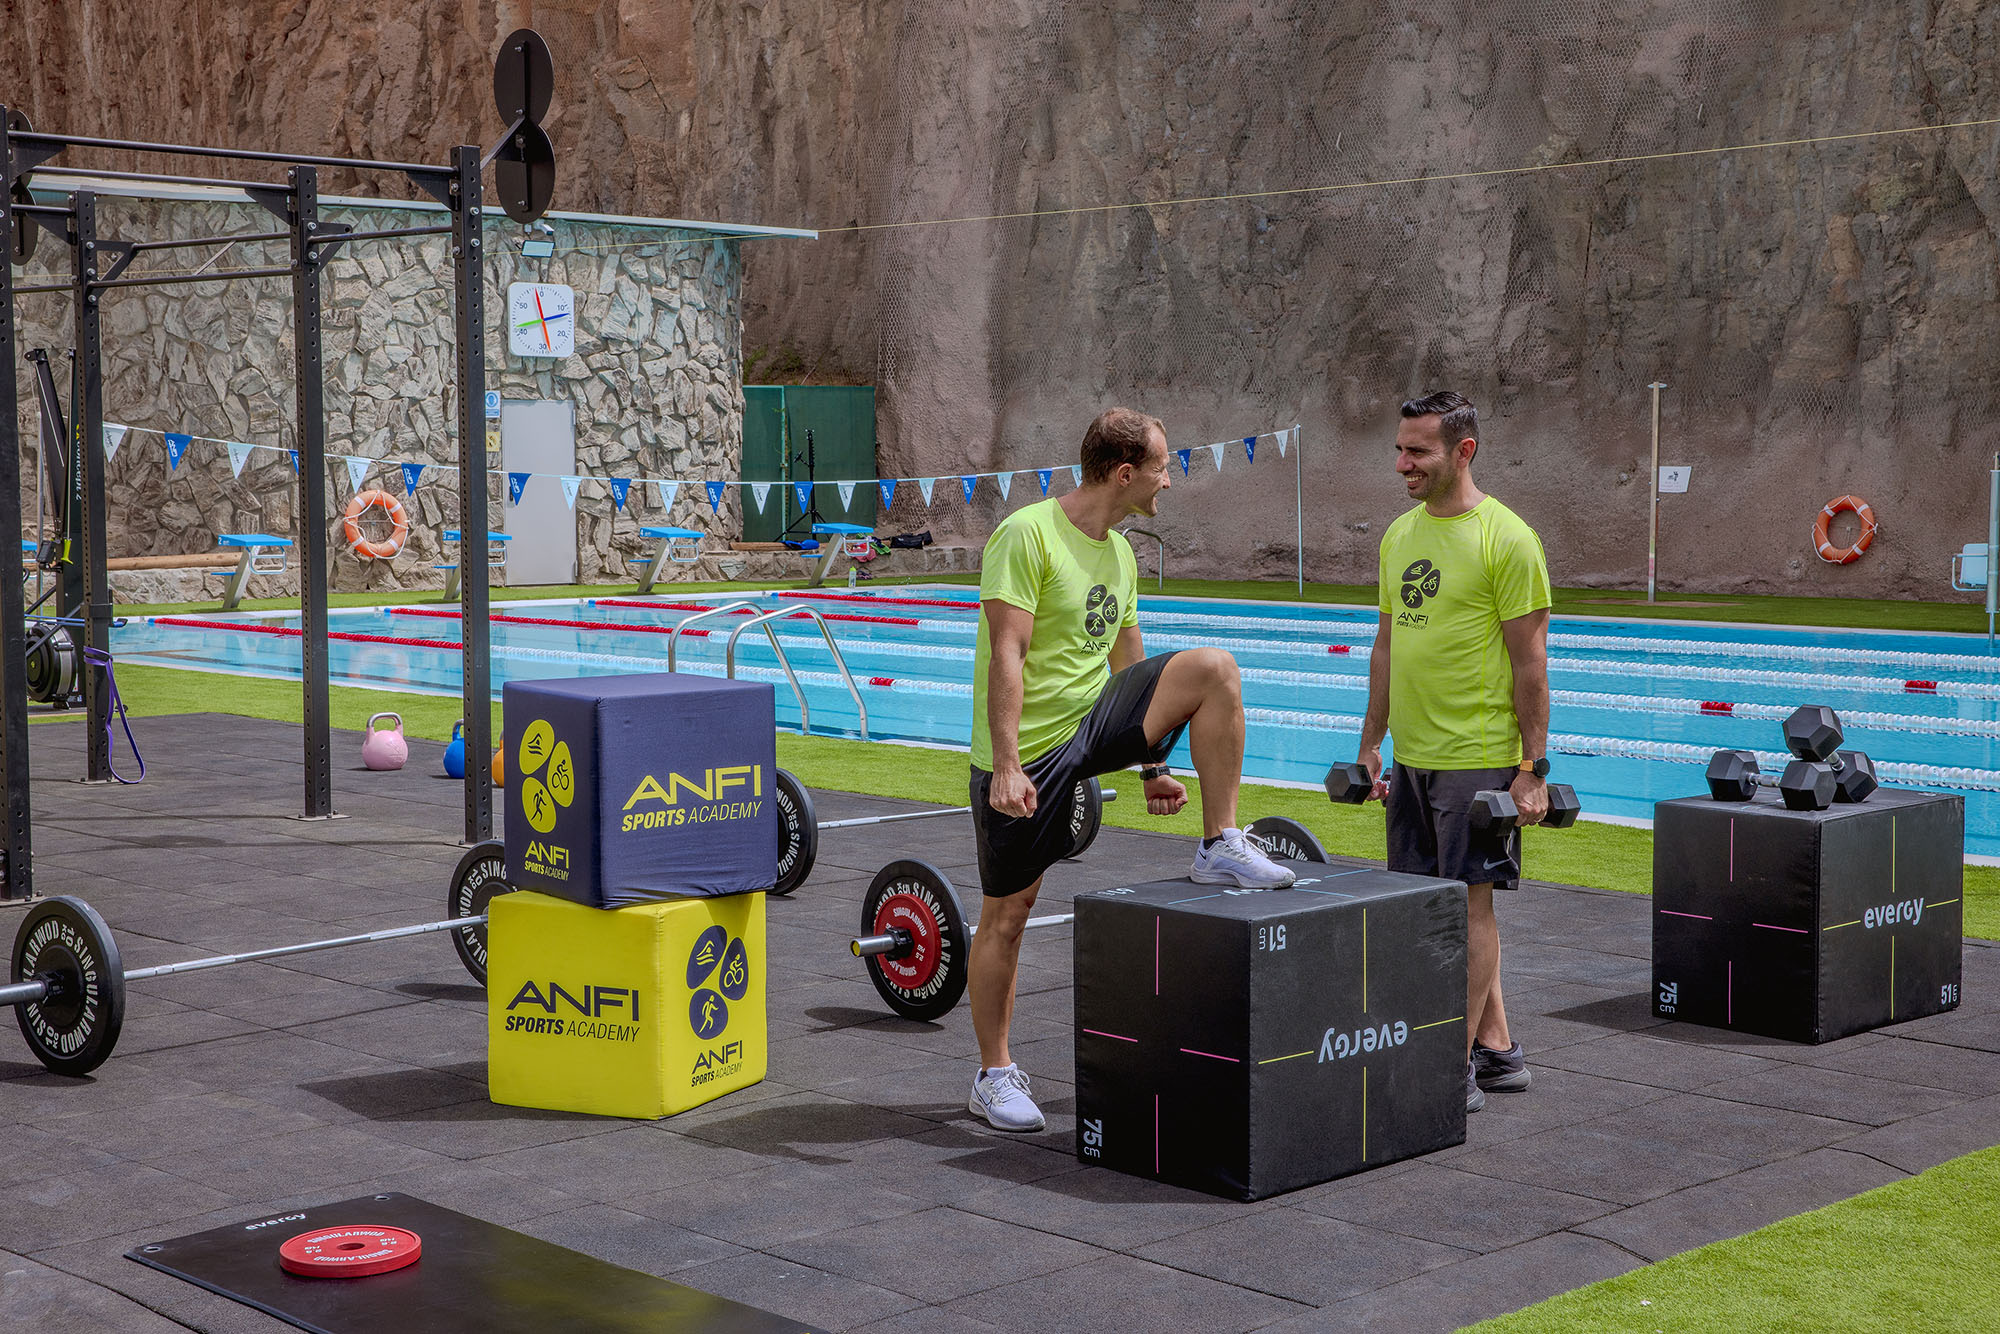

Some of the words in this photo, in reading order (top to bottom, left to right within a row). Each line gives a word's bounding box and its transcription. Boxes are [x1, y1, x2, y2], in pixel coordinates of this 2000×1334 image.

[1397, 611, 1429, 625] ANFI
[1082, 640, 1111, 652] ANFI
[622, 764, 762, 811] ANFI
[621, 808, 686, 832] SPORTS
[688, 801, 762, 824] ACADEMY
[525, 840, 570, 870] ANFI
[524, 861, 545, 875] SPORTS
[545, 865, 570, 881] ACADEMY
[1864, 897, 1925, 929] evergy
[1258, 927, 1266, 950] cm
[1269, 924, 1287, 951] 51
[60, 936, 99, 1053] SINGULARWOD
[506, 980, 640, 1021] ANFI
[1660, 982, 1677, 1005] 75
[1941, 984, 1952, 1005] 51
[1952, 984, 1958, 1002] cm
[1660, 1004, 1675, 1014] cm
[505, 1015, 565, 1035] SPORTS
[566, 1020, 640, 1043] ACADEMY
[1318, 1020, 1408, 1064] evergy
[691, 1040, 743, 1075] ANFI
[691, 1070, 715, 1087] SPORTS
[715, 1061, 743, 1080] ACADEMY
[1083, 1118, 1102, 1147] 75
[1083, 1146, 1100, 1159] cm
[245, 1213, 307, 1231] evergy
